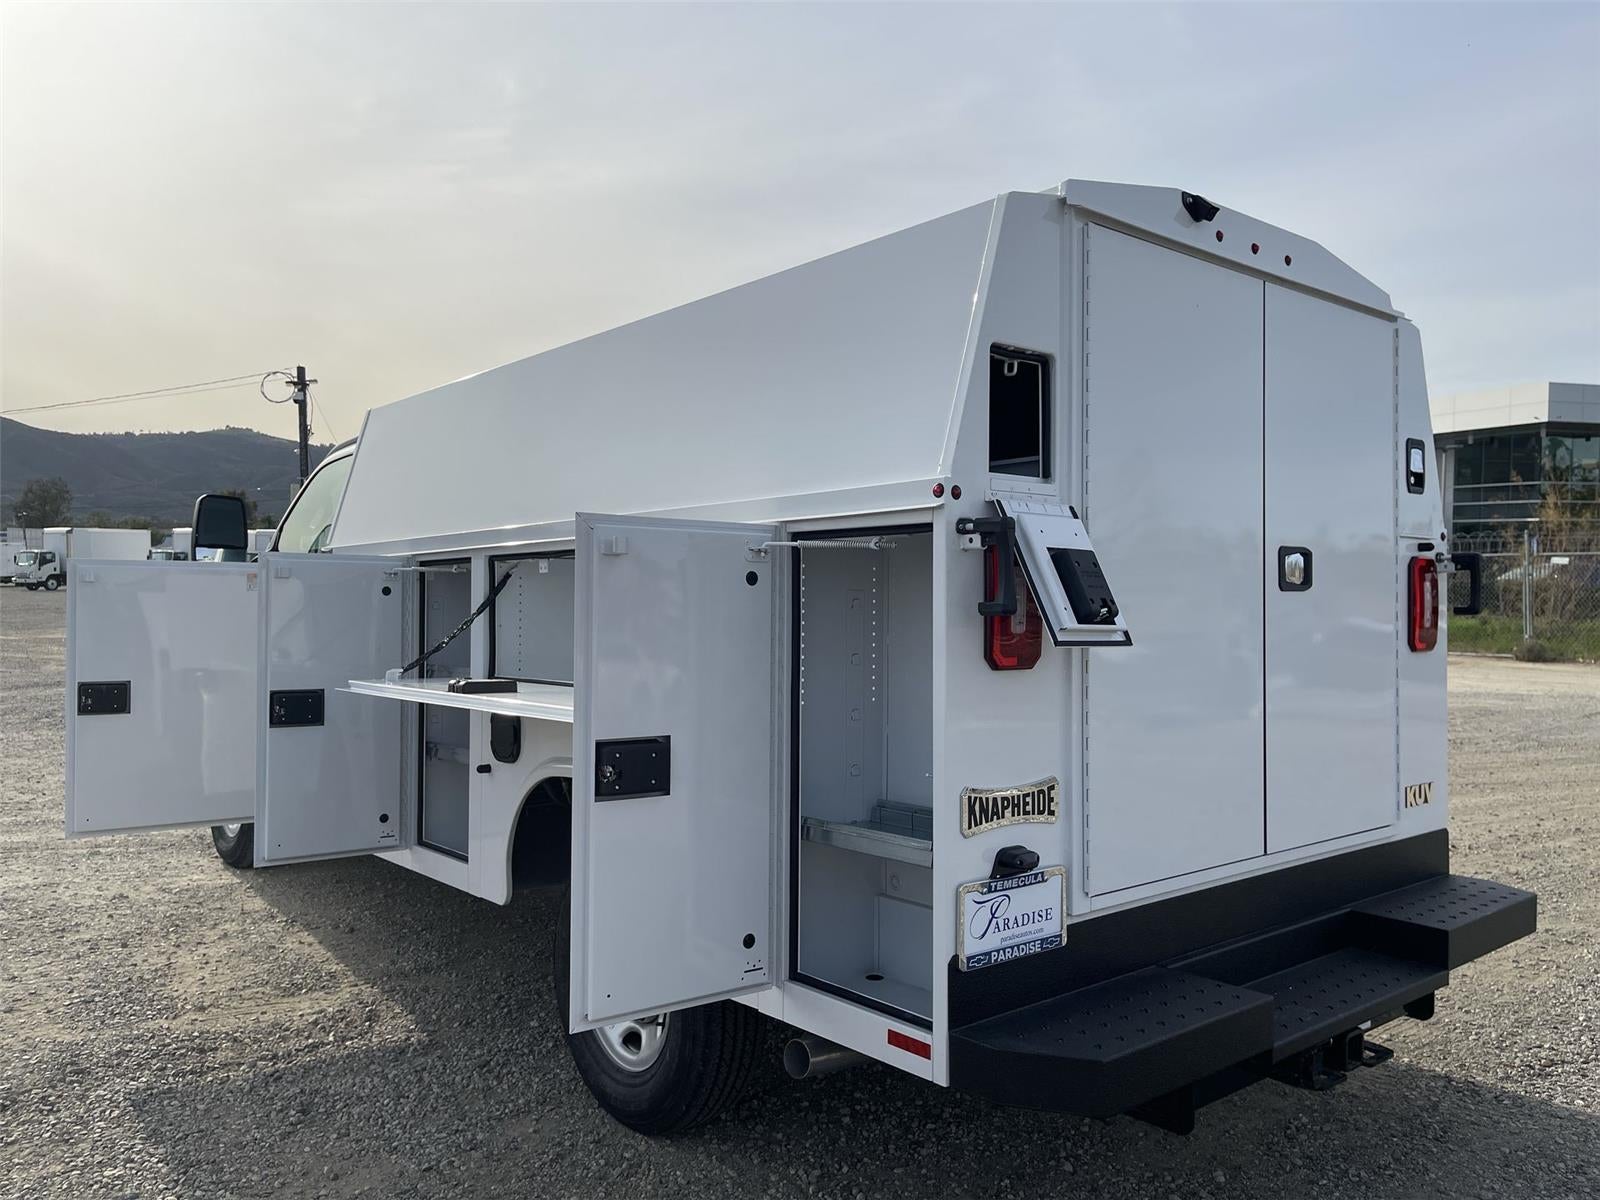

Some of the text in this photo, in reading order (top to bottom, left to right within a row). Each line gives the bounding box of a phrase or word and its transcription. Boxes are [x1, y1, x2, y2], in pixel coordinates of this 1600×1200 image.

[967, 783, 1056, 830] KNAPHEIDE
[1405, 782, 1432, 809] KUV
[990, 872, 1043, 891] TEMECULA
[969, 894, 1053, 941] PARADISE
[1000, 927, 1045, 946] paradiseautos.com
[991, 940, 1042, 964] PARADISE
